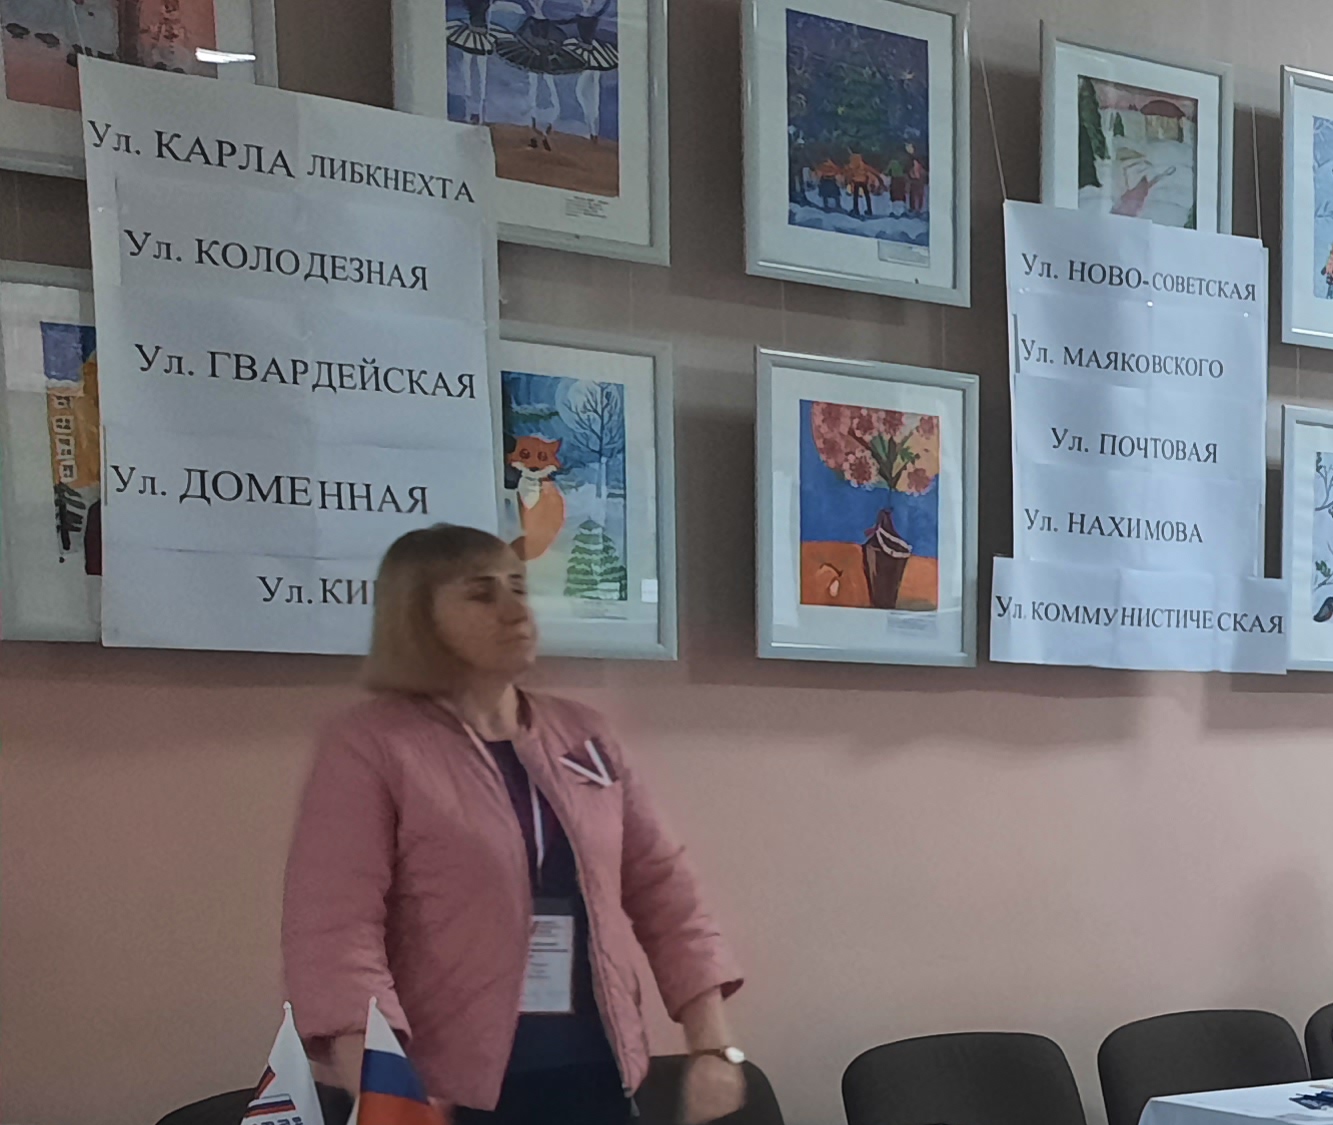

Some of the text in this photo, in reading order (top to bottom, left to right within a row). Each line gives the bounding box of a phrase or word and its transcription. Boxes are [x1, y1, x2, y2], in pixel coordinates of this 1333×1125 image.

[88, 119, 475, 203] Ул. КАРЛА ЛИБКНЕХТА
[124, 229, 429, 291] Ул. КОЛОДЕЗНАЯ
[1021, 253, 1256, 301] Ул. НОВО-СОВЕТСКАЯ
[134, 344, 476, 399] Ул. ГВАРДЕЙСКАЯ
[1021, 339, 1224, 379] Ул. МАЯКОВСКОГО
[1051, 427, 1218, 464] Ул. ПОЧТОВАЯ
[111, 464, 429, 514] Ул. ДОМЕННАЯ
[1024, 508, 1203, 543] Ул. НАХИМОВА
[319, 577, 376, 605] КИ
[1031, 601, 1284, 634] КОММУНИСТИЧЕСКАЯ
